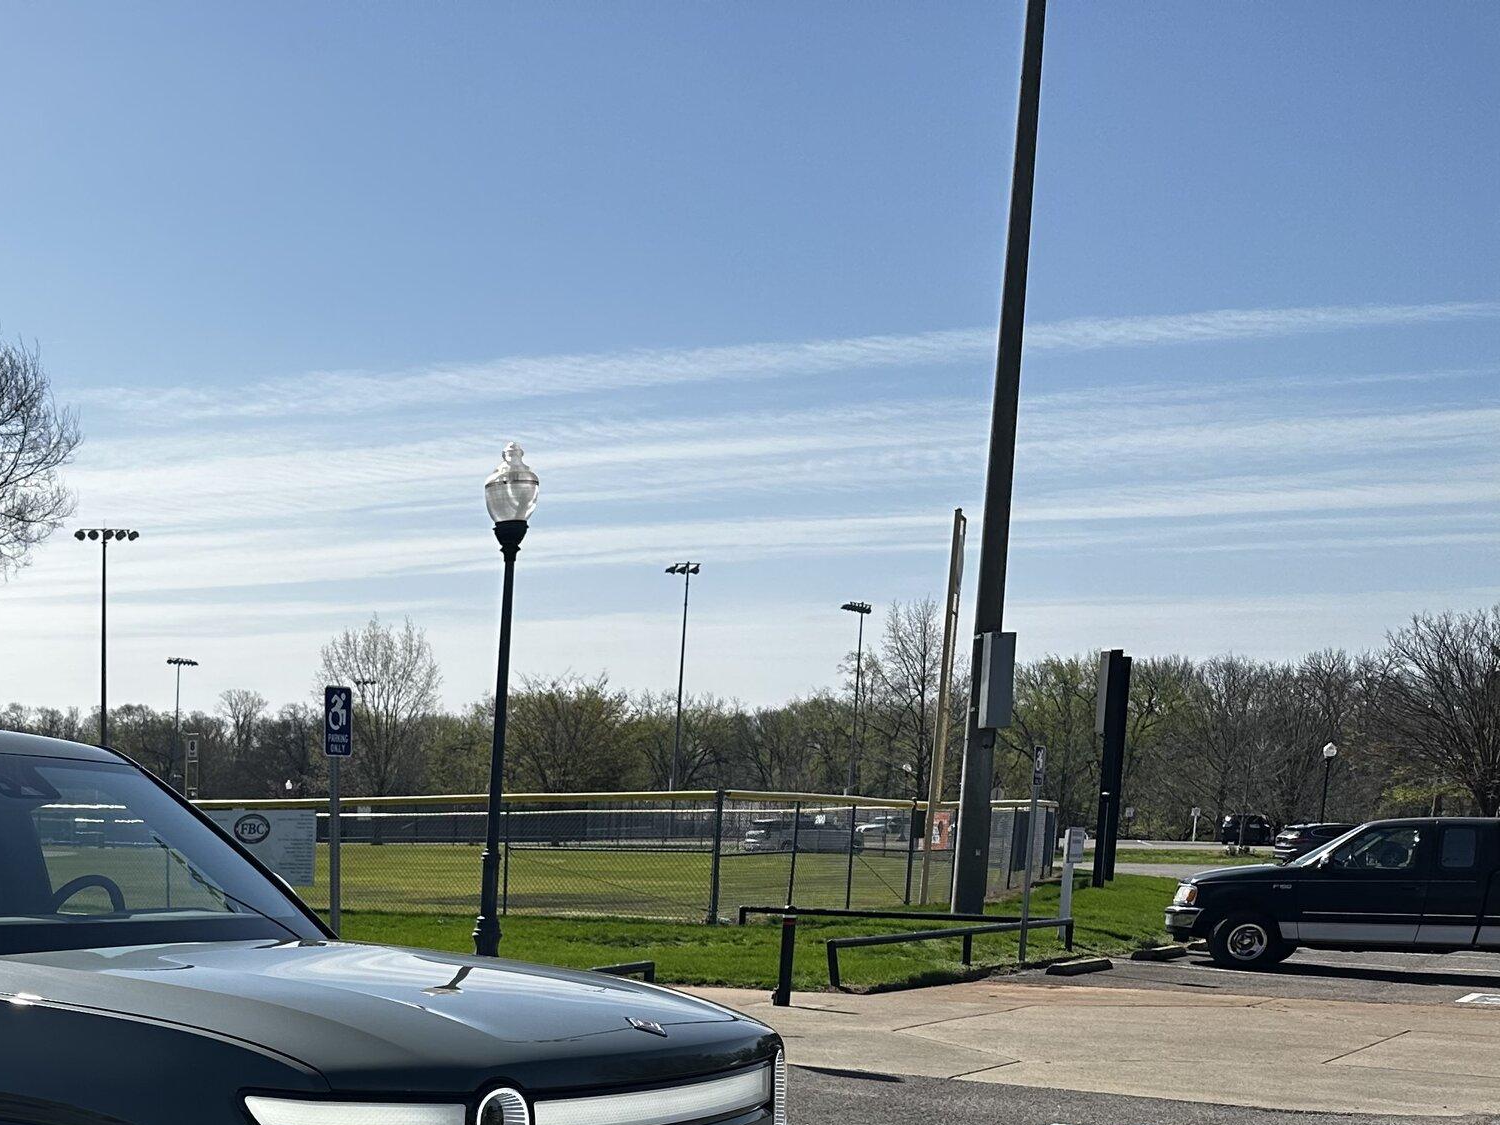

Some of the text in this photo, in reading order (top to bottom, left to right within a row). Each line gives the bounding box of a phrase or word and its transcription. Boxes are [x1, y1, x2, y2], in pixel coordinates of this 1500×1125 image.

[327, 734, 349, 743] PARKING
[330, 744, 346, 753] ONLY
[240, 823, 265, 835] FBC
